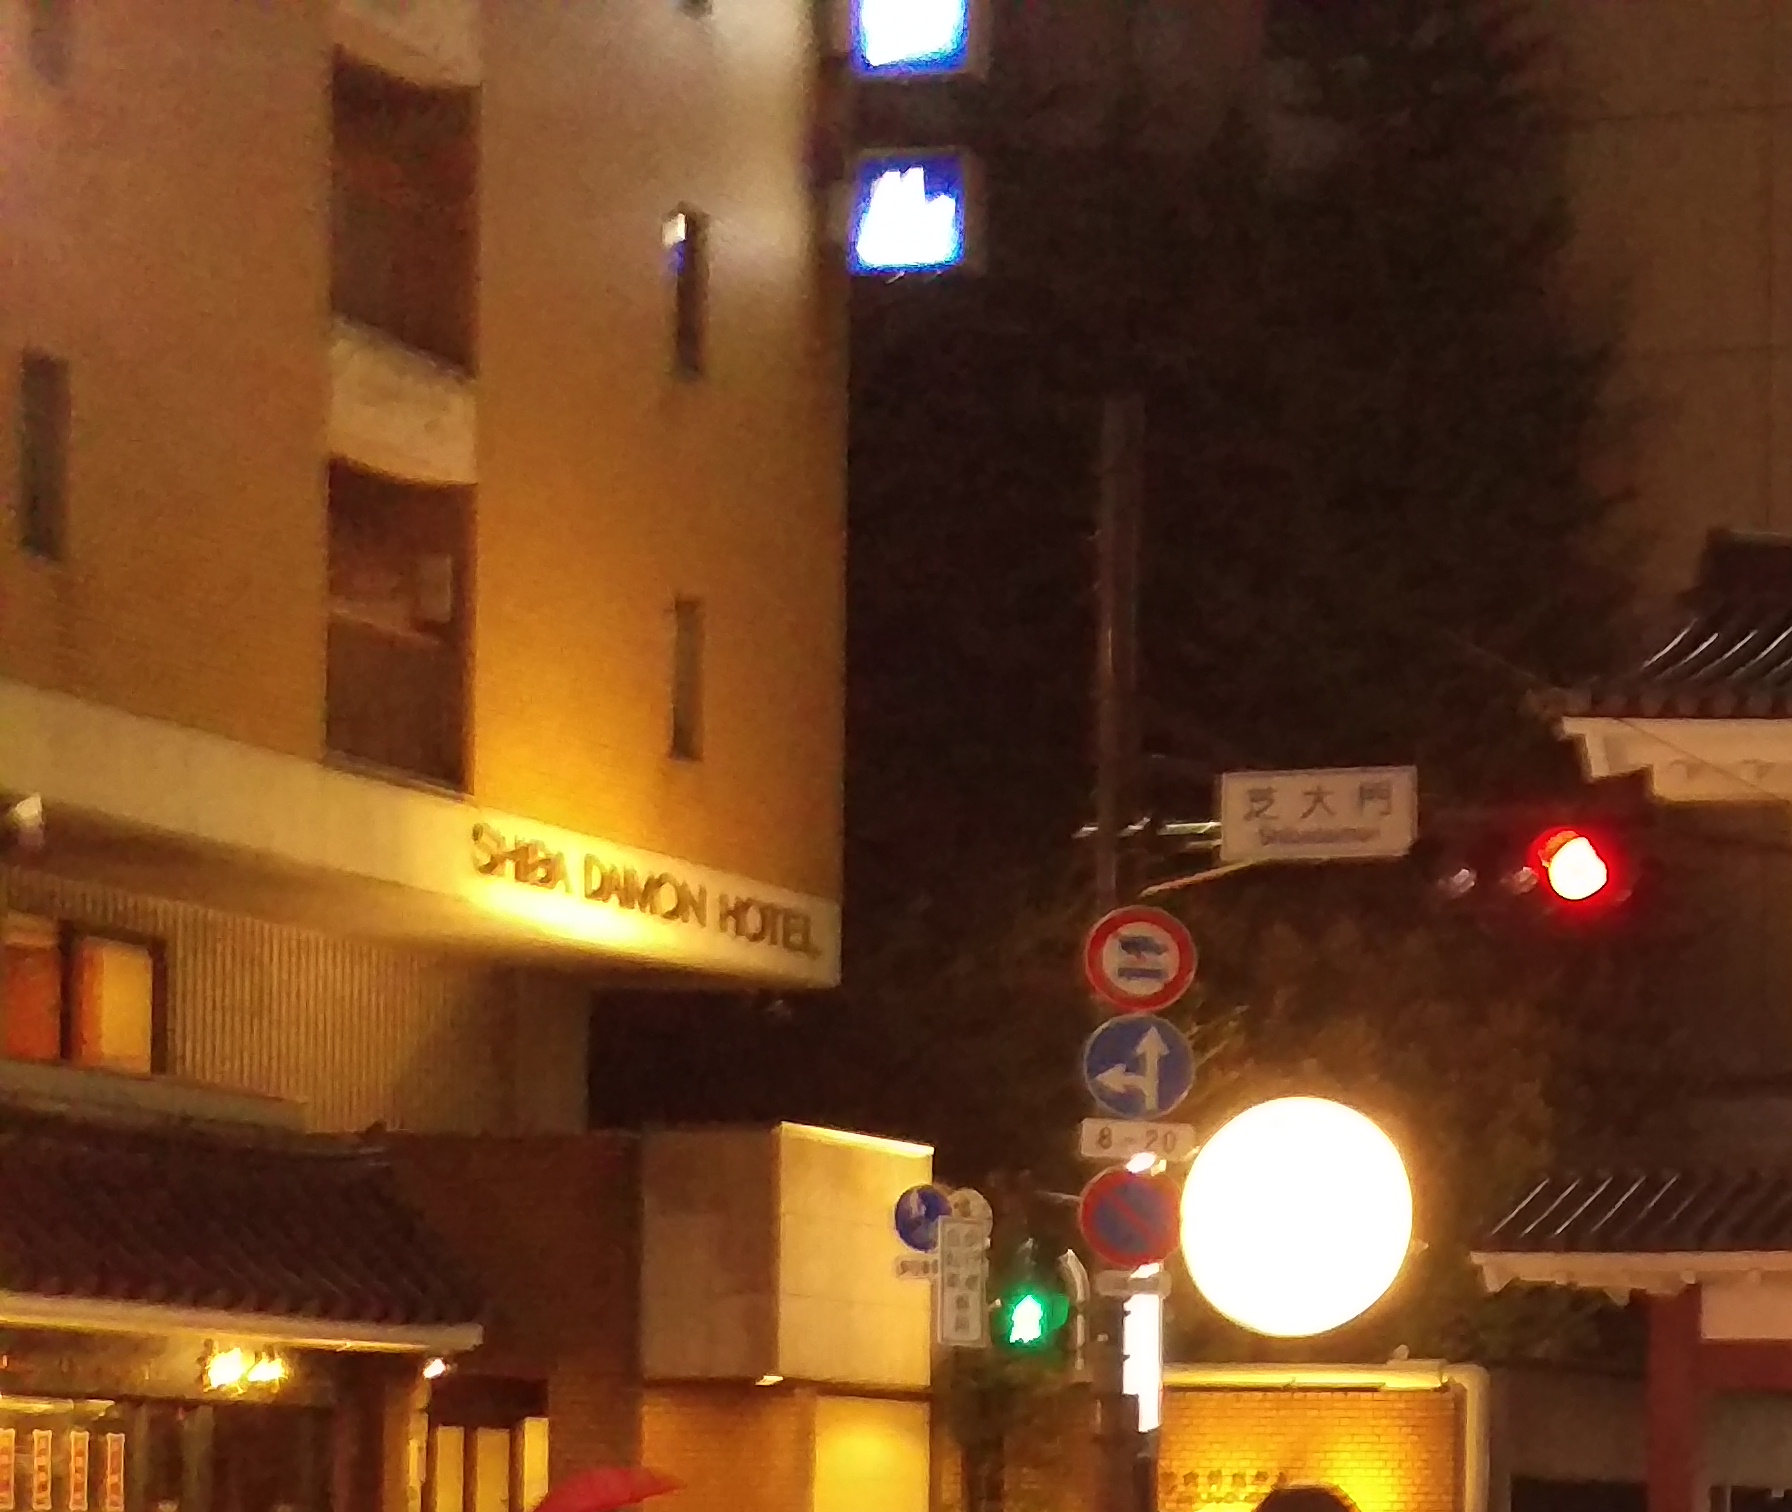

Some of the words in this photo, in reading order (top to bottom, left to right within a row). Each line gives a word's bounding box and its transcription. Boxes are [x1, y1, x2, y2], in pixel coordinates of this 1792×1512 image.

[1243, 780, 1393, 822] 芝大門
[471, 822, 573, 893] SHIBA
[584, 853, 707, 927] DAIMON
[719, 892, 822, 959] HOTEL
